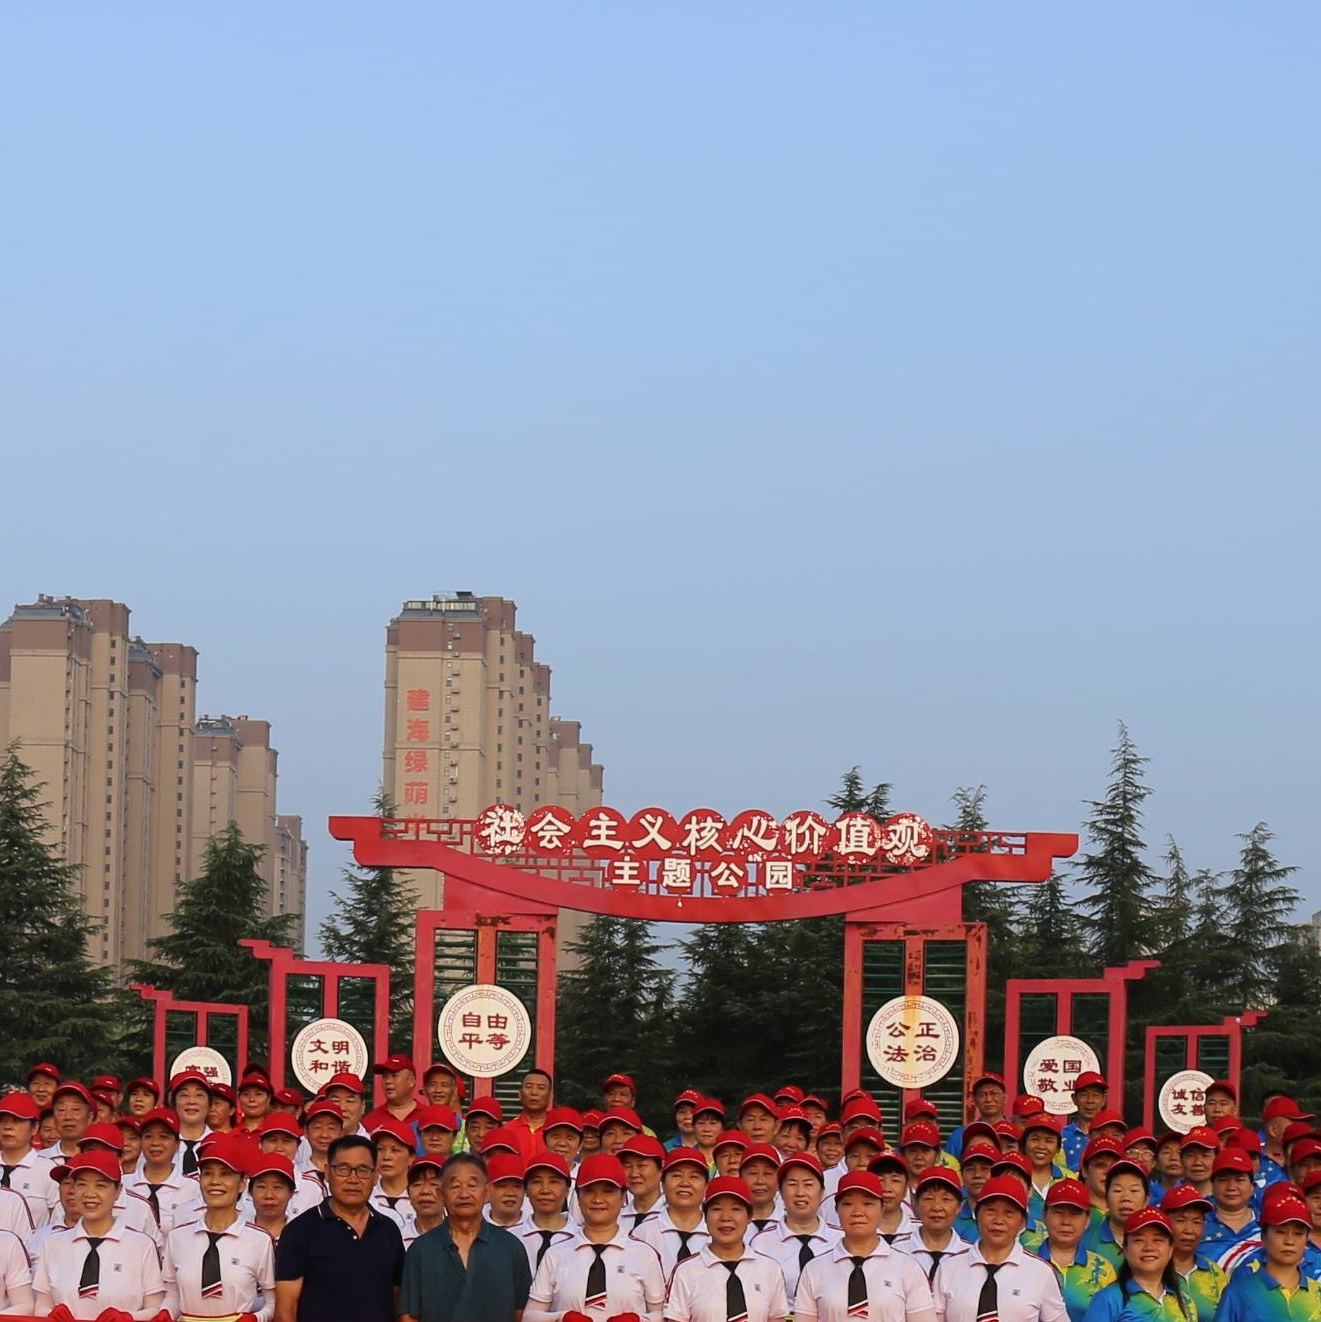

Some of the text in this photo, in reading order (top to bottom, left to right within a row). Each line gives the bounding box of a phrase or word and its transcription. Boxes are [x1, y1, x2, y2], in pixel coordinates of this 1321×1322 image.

[481, 808, 929, 858] 社会主义核心价值观
[612, 856, 794, 890] 主题公园
[462, 1012, 508, 1029] 自由
[886, 1022, 940, 1038] 公正
[309, 1039, 350, 1055] 文明
[458, 1033, 510, 1050] 平等
[883, 1045, 937, 1062] 法治
[309, 1059, 351, 1073] 和谐
[1038, 1058, 1082, 1074] 爱国
[1172, 1088, 1206, 1101] 诚信
[1172, 1104, 1204, 1116] 友善
